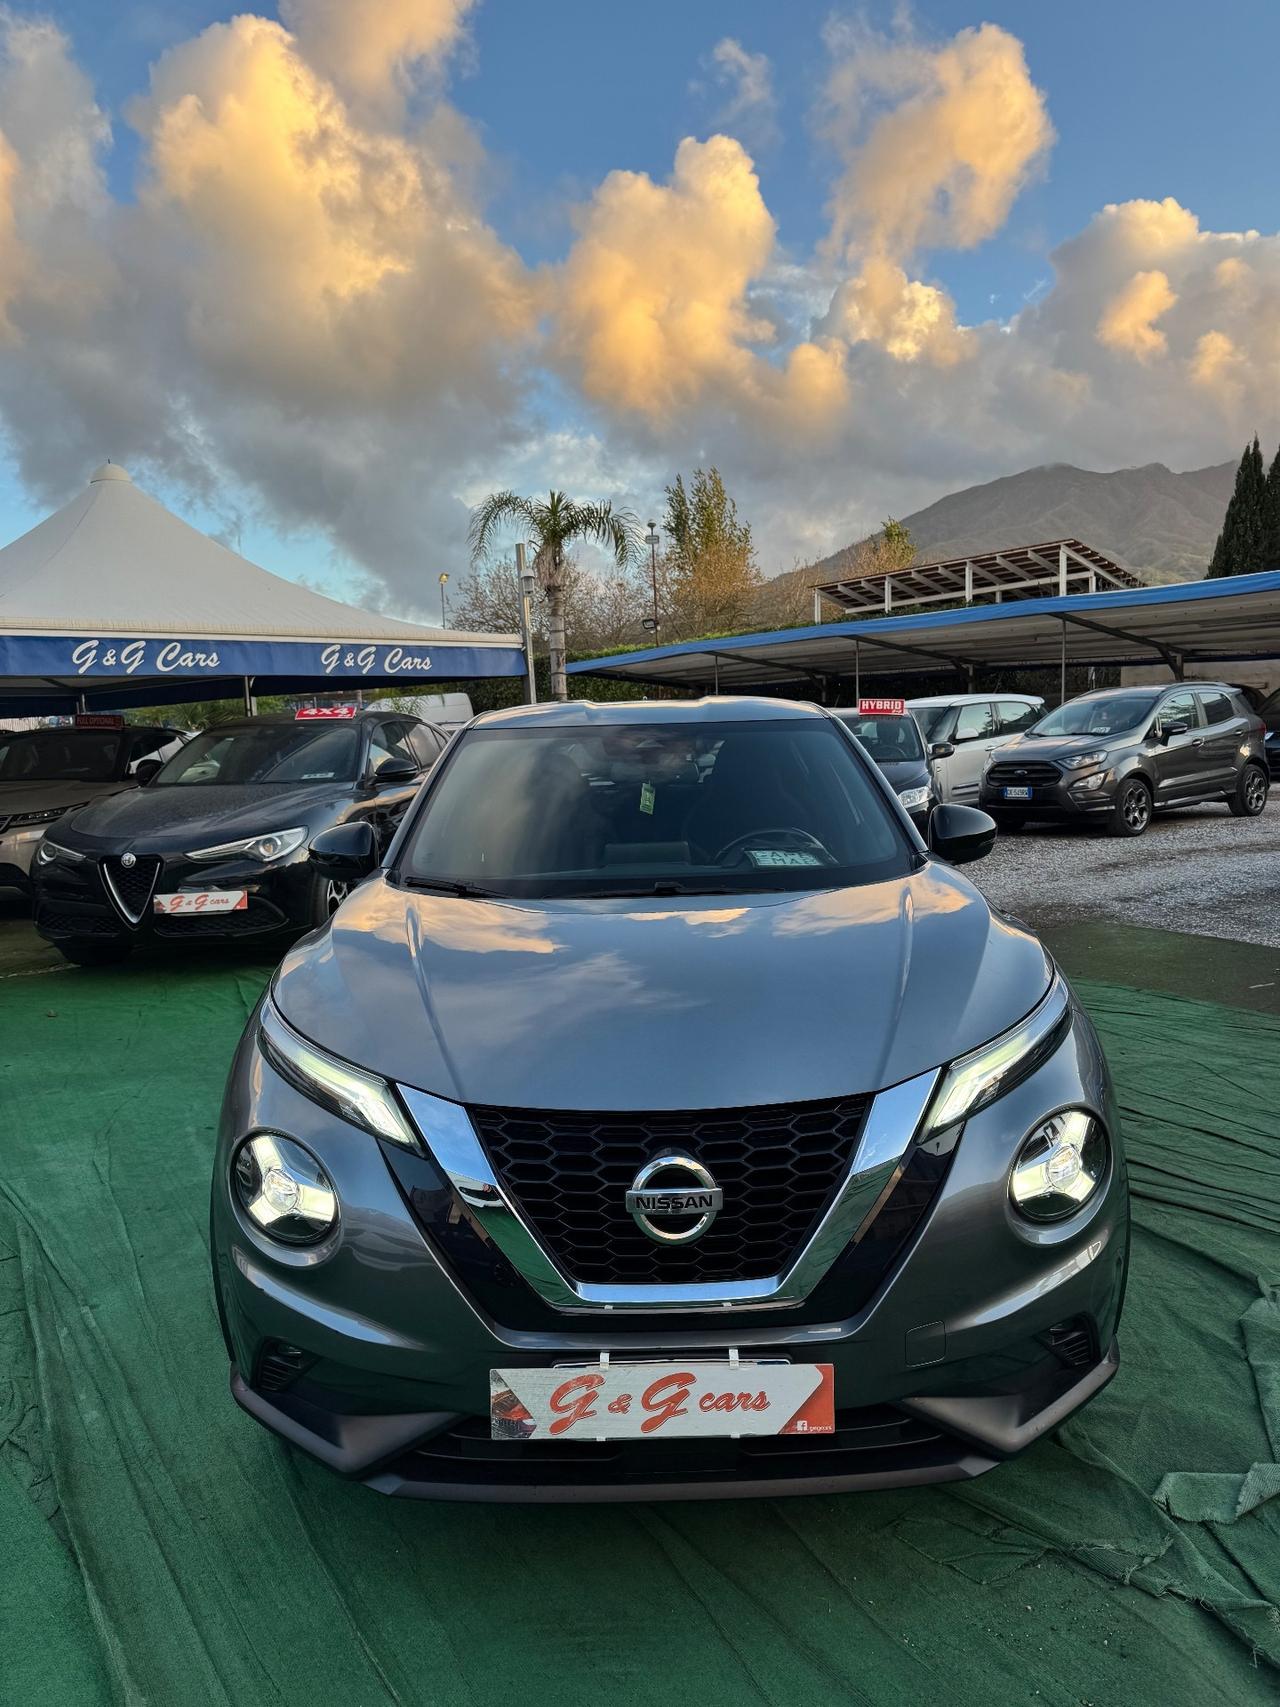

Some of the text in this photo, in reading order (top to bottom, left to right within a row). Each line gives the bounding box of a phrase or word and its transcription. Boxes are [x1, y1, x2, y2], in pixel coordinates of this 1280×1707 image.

[156, 642, 221, 672] Cars
[383, 648, 433, 674] Cars
[862, 701, 902, 710] HYBRID
[635, 1194, 713, 1210] NISSAN
[698, 1390, 771, 1413] cars
